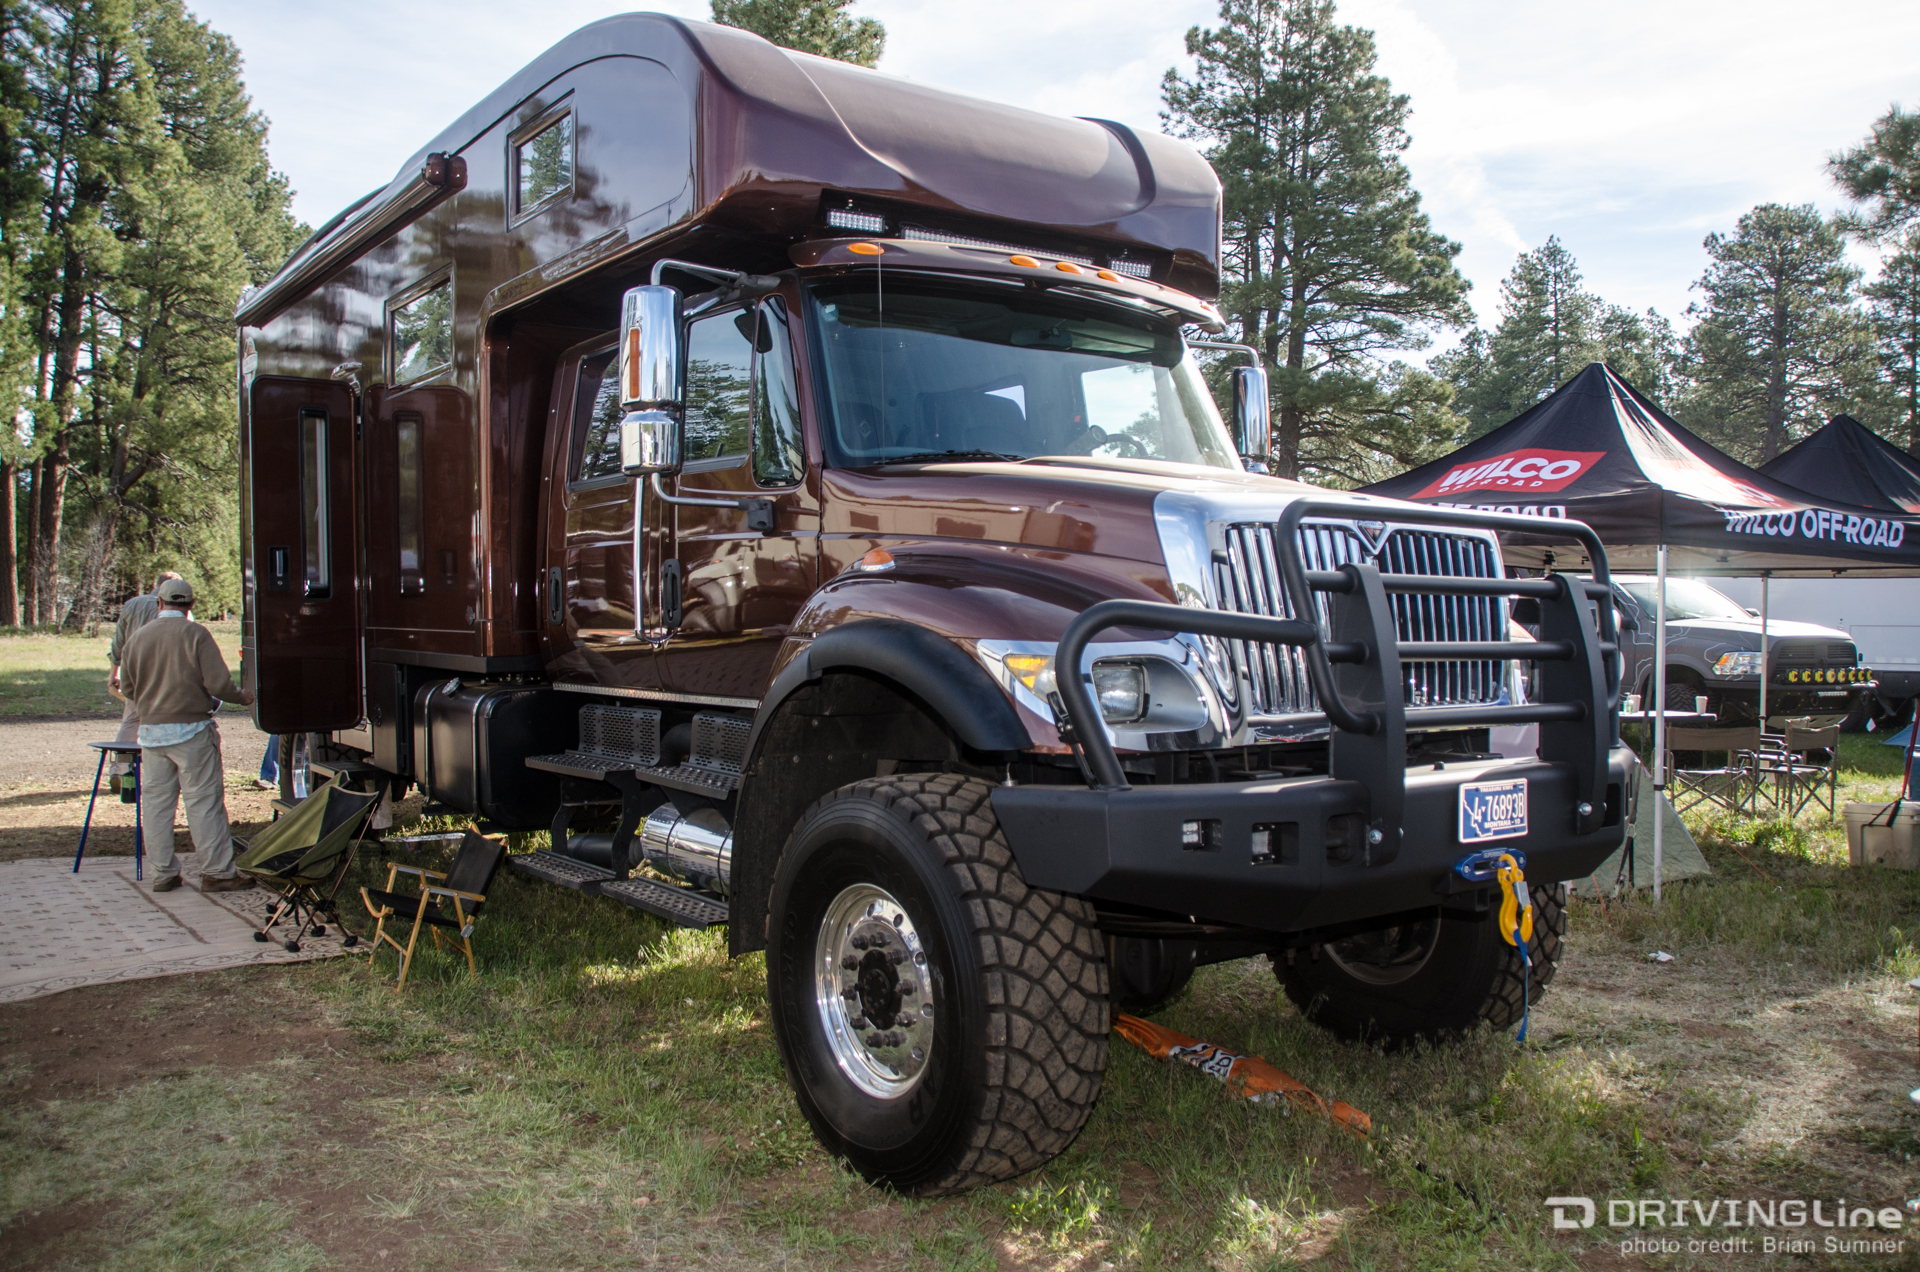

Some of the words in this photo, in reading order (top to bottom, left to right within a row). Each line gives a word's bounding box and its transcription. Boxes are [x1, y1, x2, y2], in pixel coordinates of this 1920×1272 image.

[1439, 457, 1582, 488] WILCO
[1721, 508, 1797, 537] WILCO
[1800, 509, 1905, 548] OFF-ROAD
[1484, 820, 1512, 829] MONTANA
